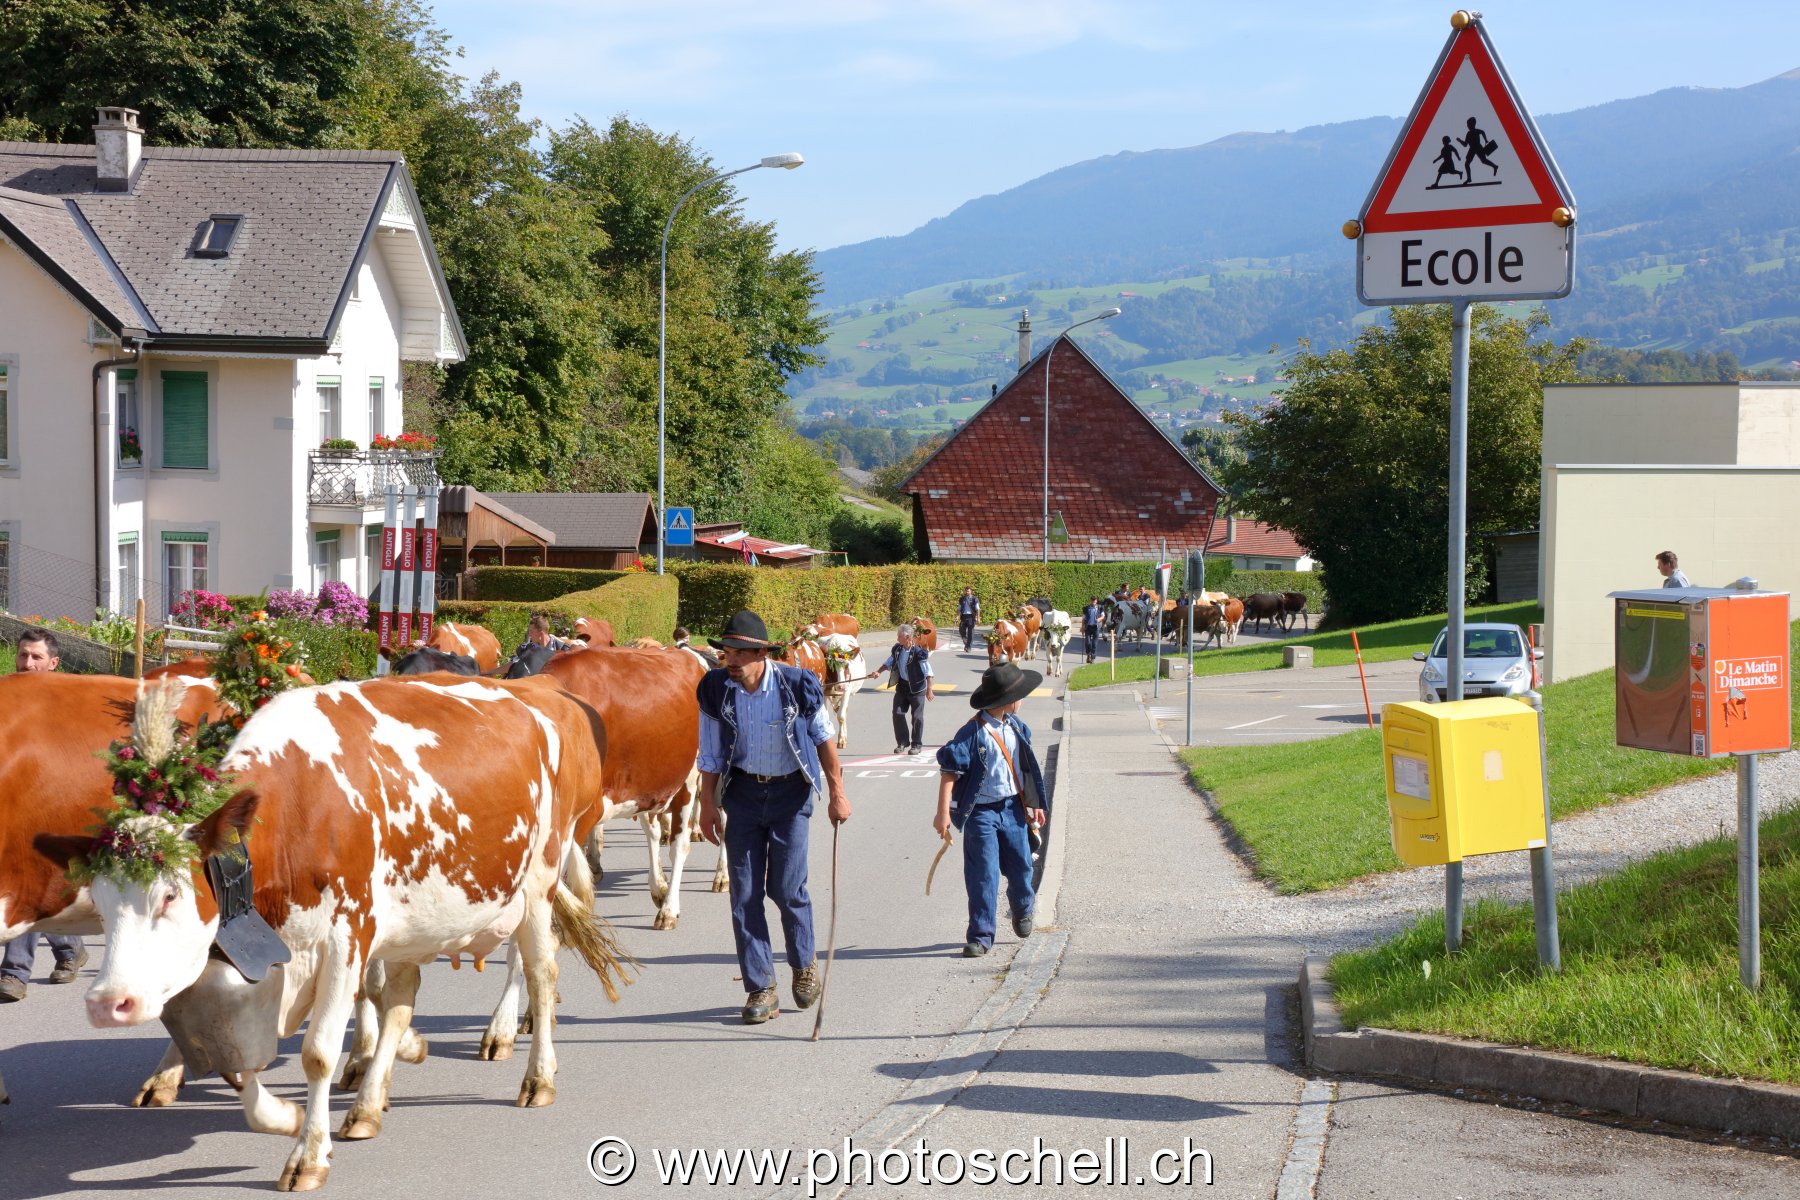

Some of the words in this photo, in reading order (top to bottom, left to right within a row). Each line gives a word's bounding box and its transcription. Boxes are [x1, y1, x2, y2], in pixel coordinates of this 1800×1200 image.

[1401, 232, 1523, 287] Ecole
[1728, 663, 1743, 675] Le
[1744, 660, 1778, 674] Matin
[1720, 673, 1778, 688] Dimanche
